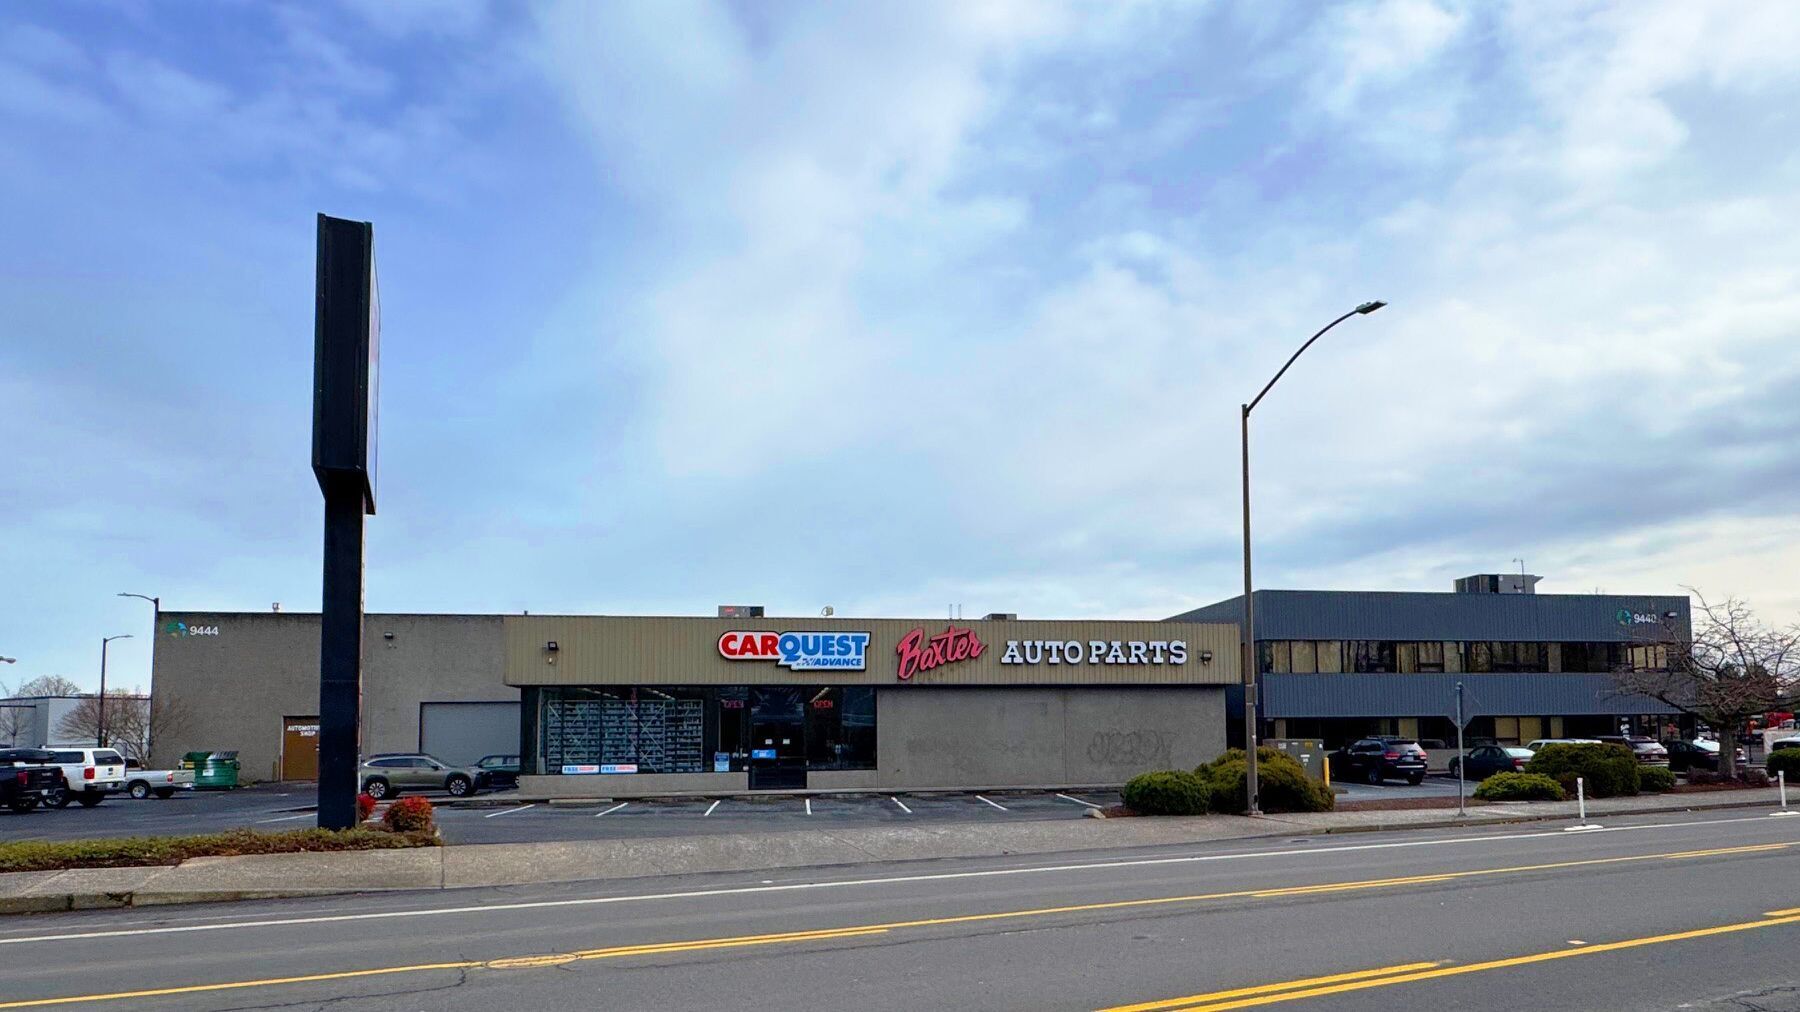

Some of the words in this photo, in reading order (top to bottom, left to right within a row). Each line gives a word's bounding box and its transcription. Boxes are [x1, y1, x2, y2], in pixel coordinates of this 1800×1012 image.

[189, 625, 219, 636] 9444
[721, 634, 867, 662] CARQUEST
[897, 626, 986, 680] Baxter
[1001, 640, 1083, 664] AUTO
[1088, 640, 1188, 664] PARTS
[814, 658, 862, 666] ADVANCE
[813, 700, 833, 708] OPEN
